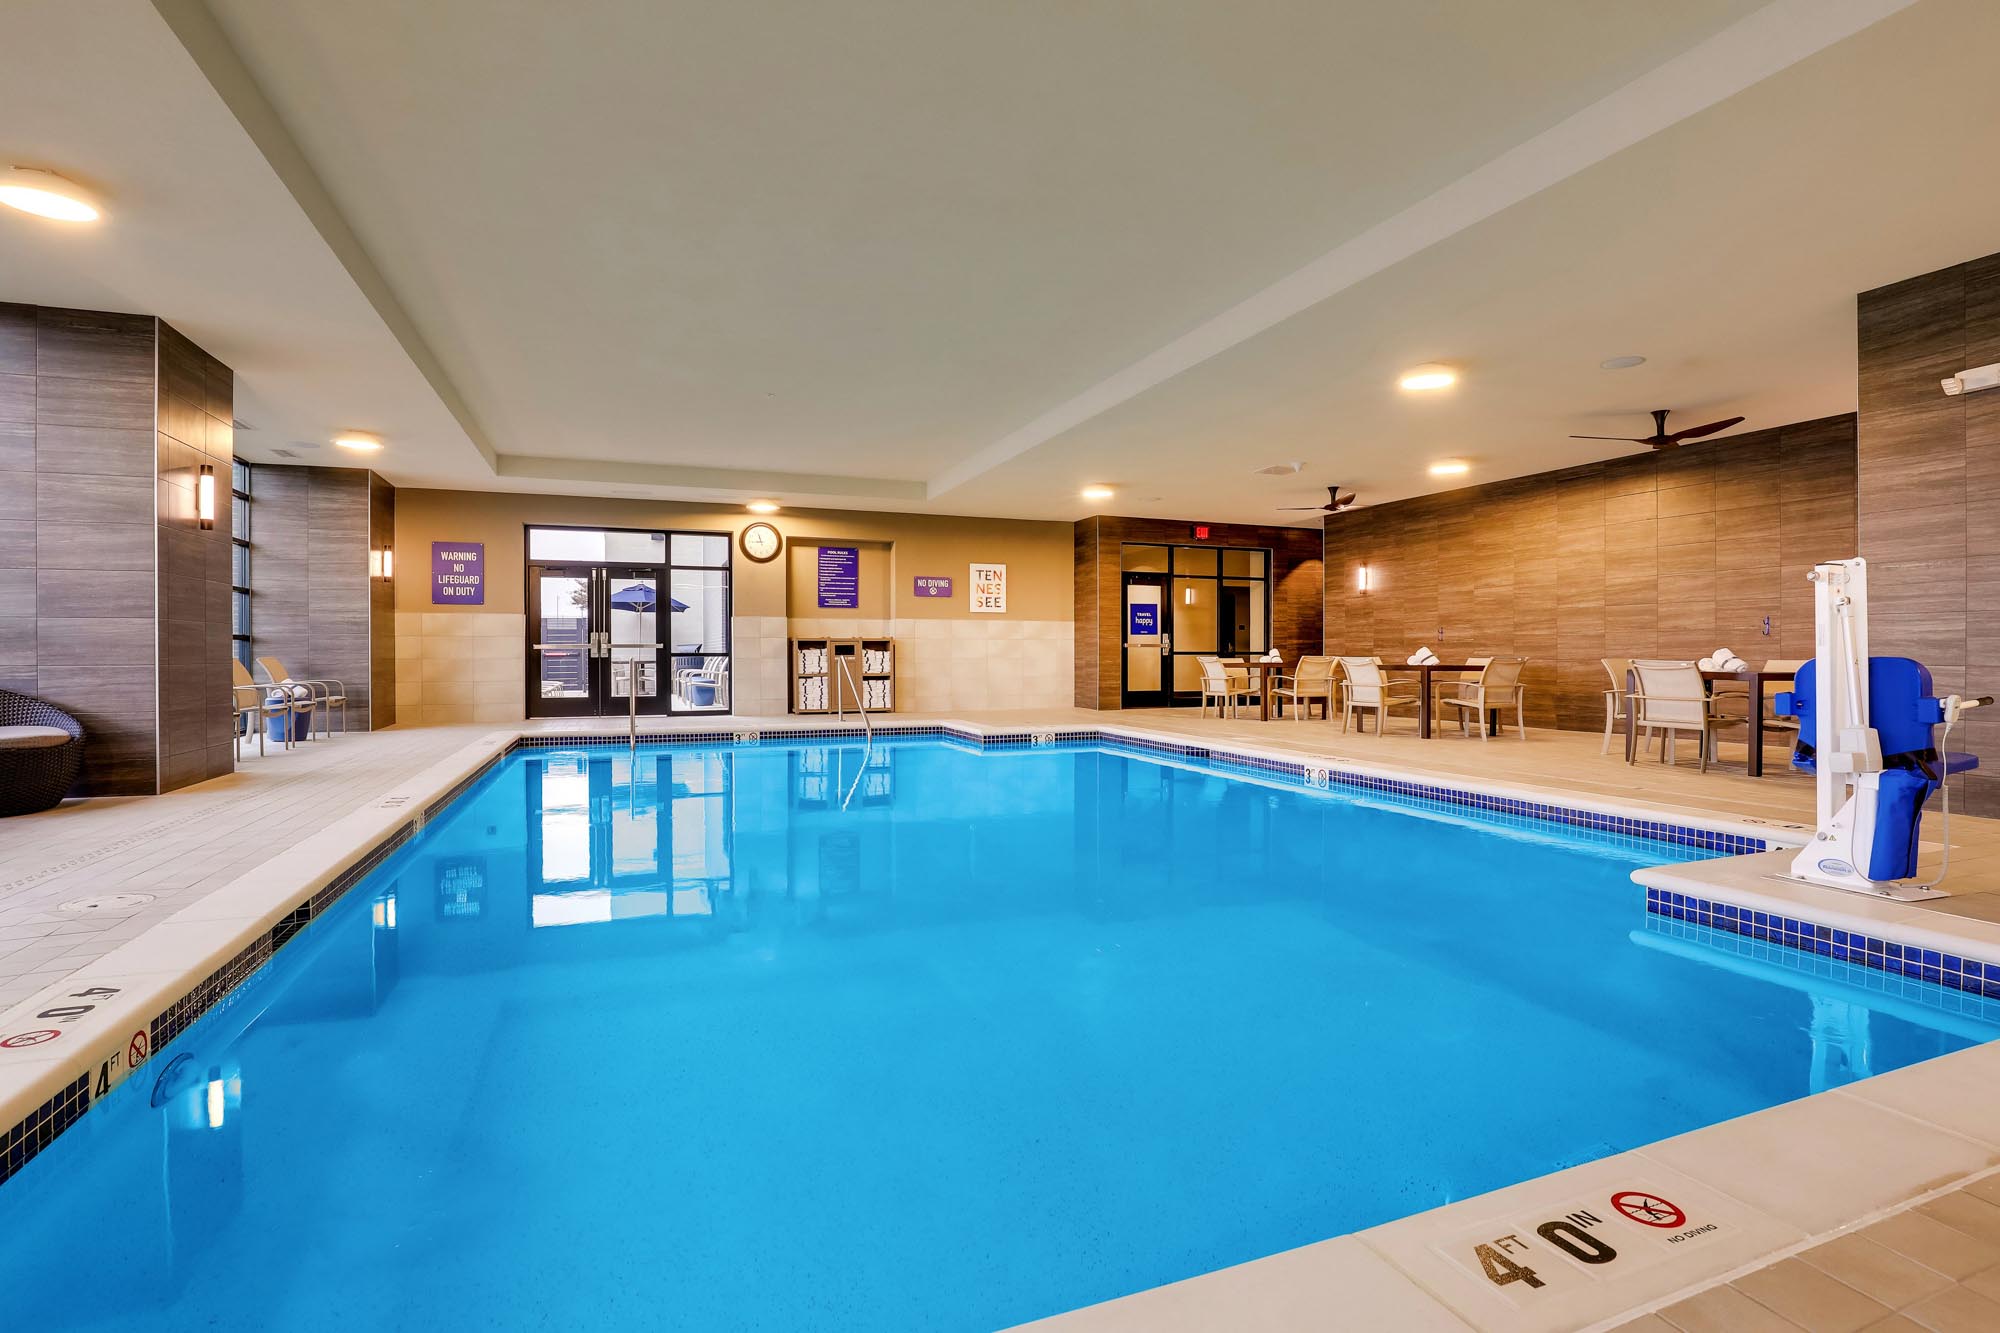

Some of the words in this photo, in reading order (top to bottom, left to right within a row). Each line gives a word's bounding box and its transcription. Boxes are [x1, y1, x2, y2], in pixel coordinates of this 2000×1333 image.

[440, 552, 476, 561] WARNING
[454, 564, 464, 572] NO
[438, 575, 480, 584] LIFEGUARD
[976, 570, 1002, 582] TEN
[918, 578, 926, 587] NO
[928, 580, 948, 588] DIVING
[443, 586, 454, 596] ON
[456, 587, 476, 596] DUTY
[976, 584, 1002, 594] NES
[976, 596, 1002, 608] SEE
[1135, 616, 1153, 626] happy
[1667, 1234, 1685, 1244] NO
[1685, 1224, 1718, 1240] DIVING
